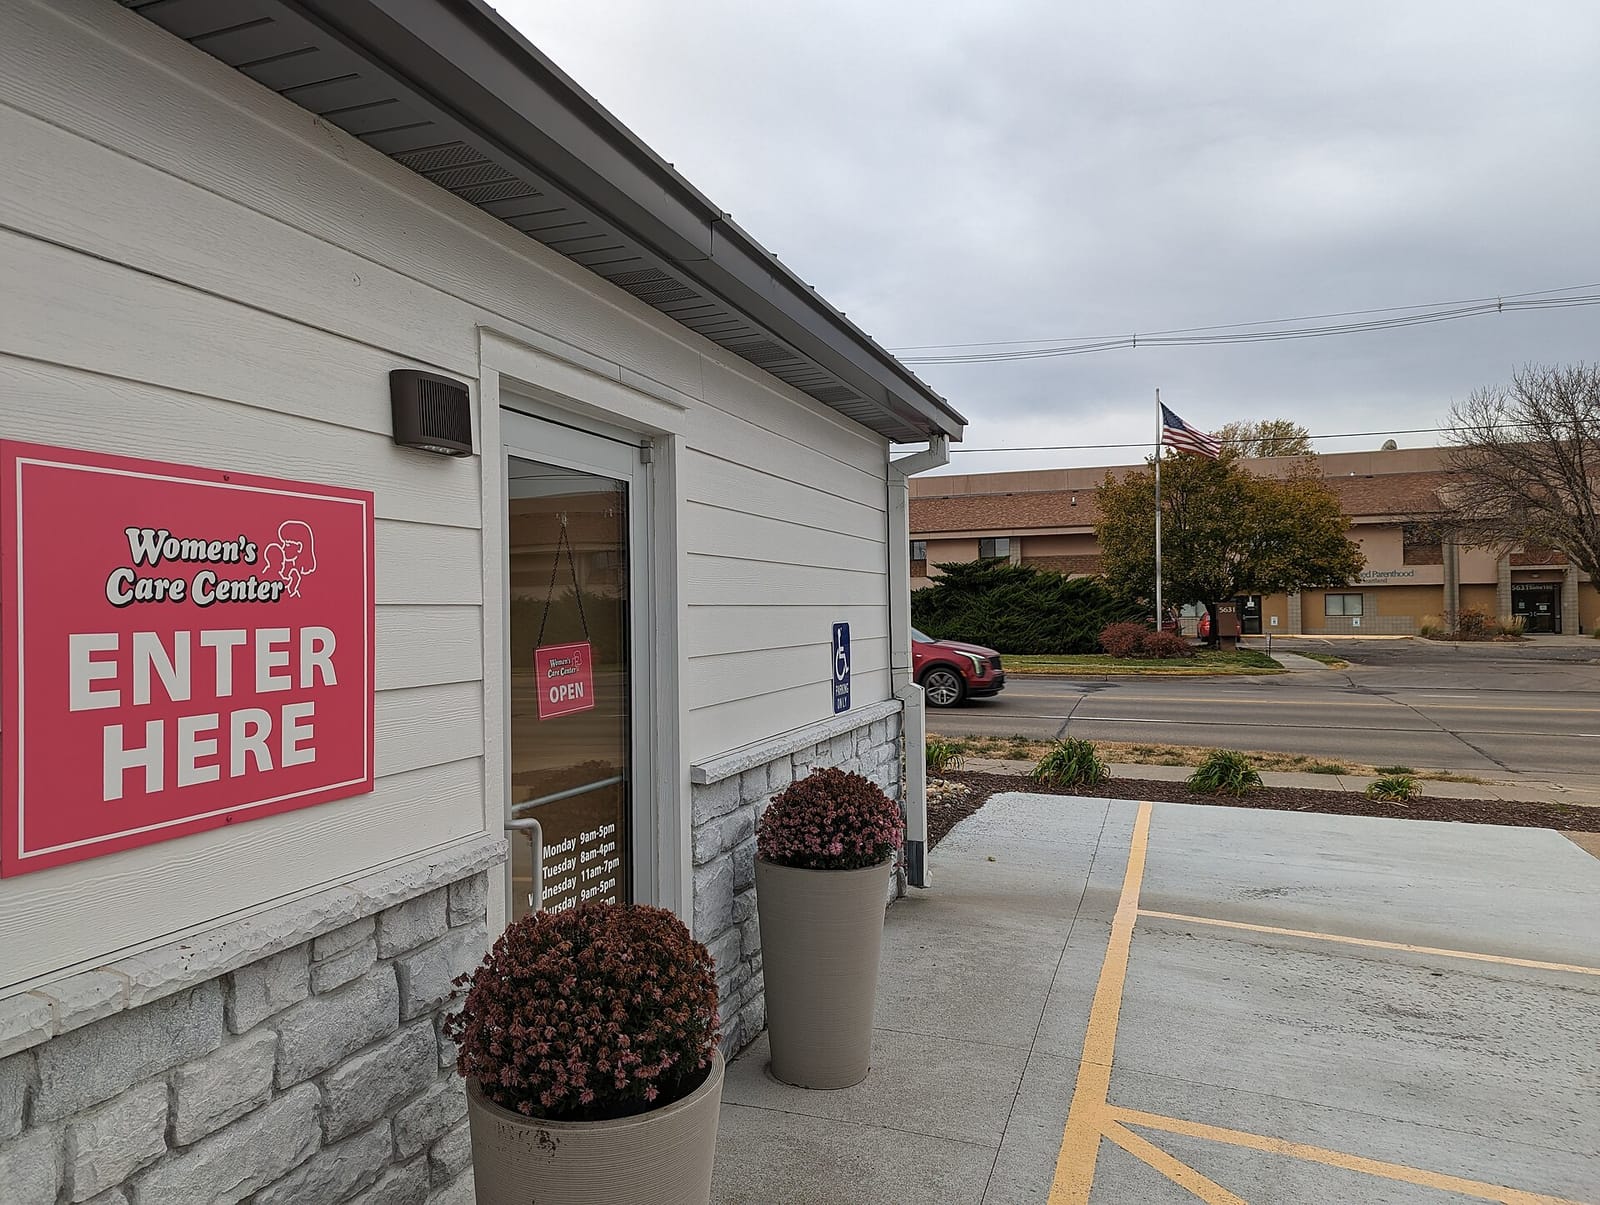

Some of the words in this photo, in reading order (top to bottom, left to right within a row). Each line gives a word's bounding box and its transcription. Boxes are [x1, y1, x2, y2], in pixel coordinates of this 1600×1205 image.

[125, 527, 258, 566] Women's
[106, 567, 187, 607] Care
[191, 570, 285, 607] Center
[1372, 569, 1414, 578] Parenthood
[68, 626, 338, 712] ENTER
[547, 668, 560, 678] Care
[560, 667, 577, 676] Center
[549, 657, 571, 668] Women's
[549, 682, 584, 703] OPEN
[103, 701, 316, 802] HERE
[543, 837, 577, 859] Monday
[580, 823, 615, 845] 9am-5pm
[543, 856, 577, 879] Tuesday
[580, 841, 615, 863] 8am-4pm
[581, 857, 620, 882] 11am-7pm
[581, 877, 616, 901] 9am-5pm
